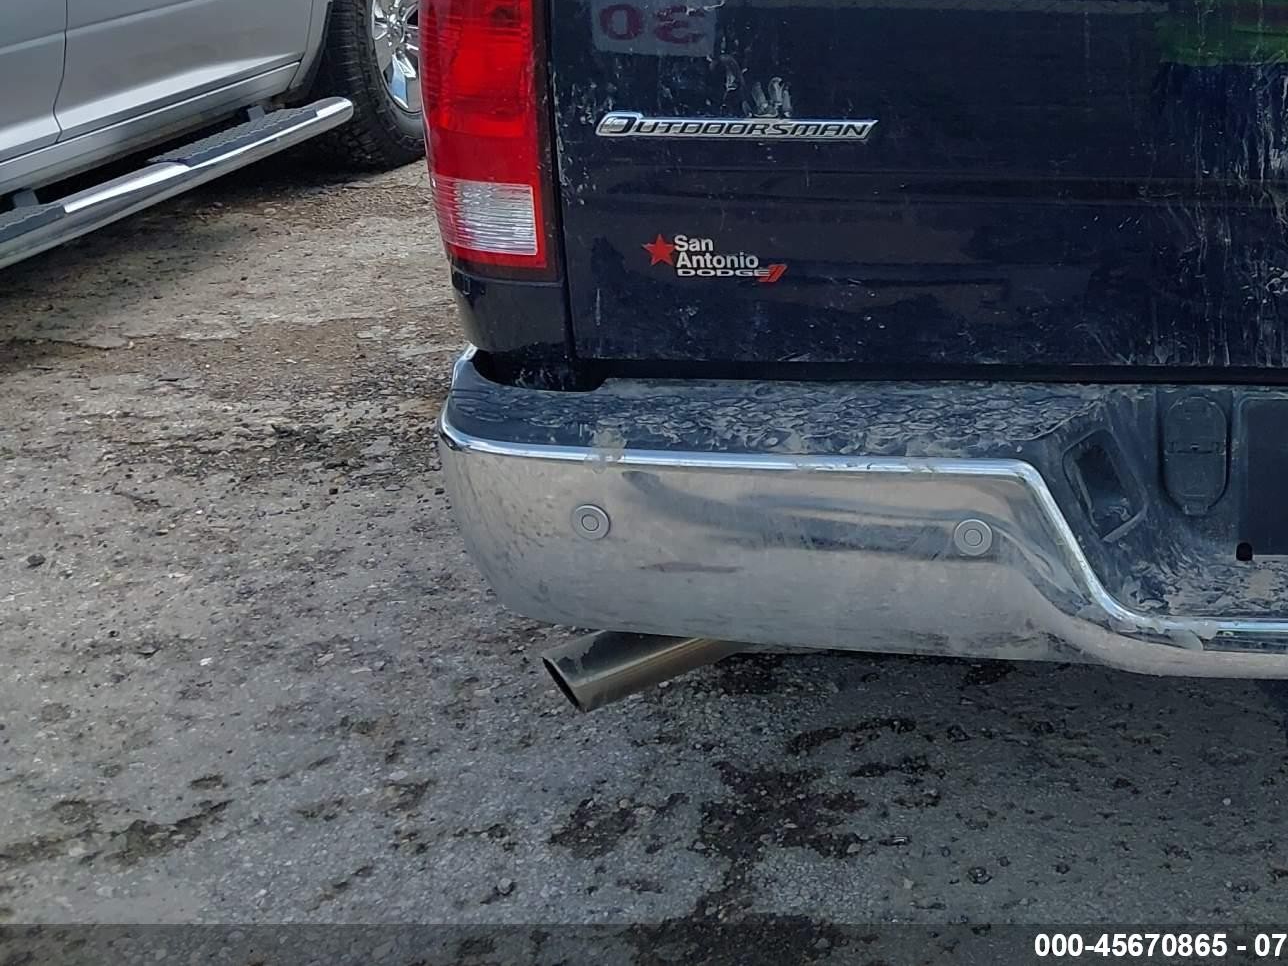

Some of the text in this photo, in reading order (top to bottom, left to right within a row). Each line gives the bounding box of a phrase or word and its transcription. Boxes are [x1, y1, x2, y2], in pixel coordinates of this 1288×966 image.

[598, 113, 876, 138] OUTDOORSMAN
[674, 234, 714, 253] San
[676, 251, 760, 269] Antonio
[676, 268, 771, 277] DODGE
